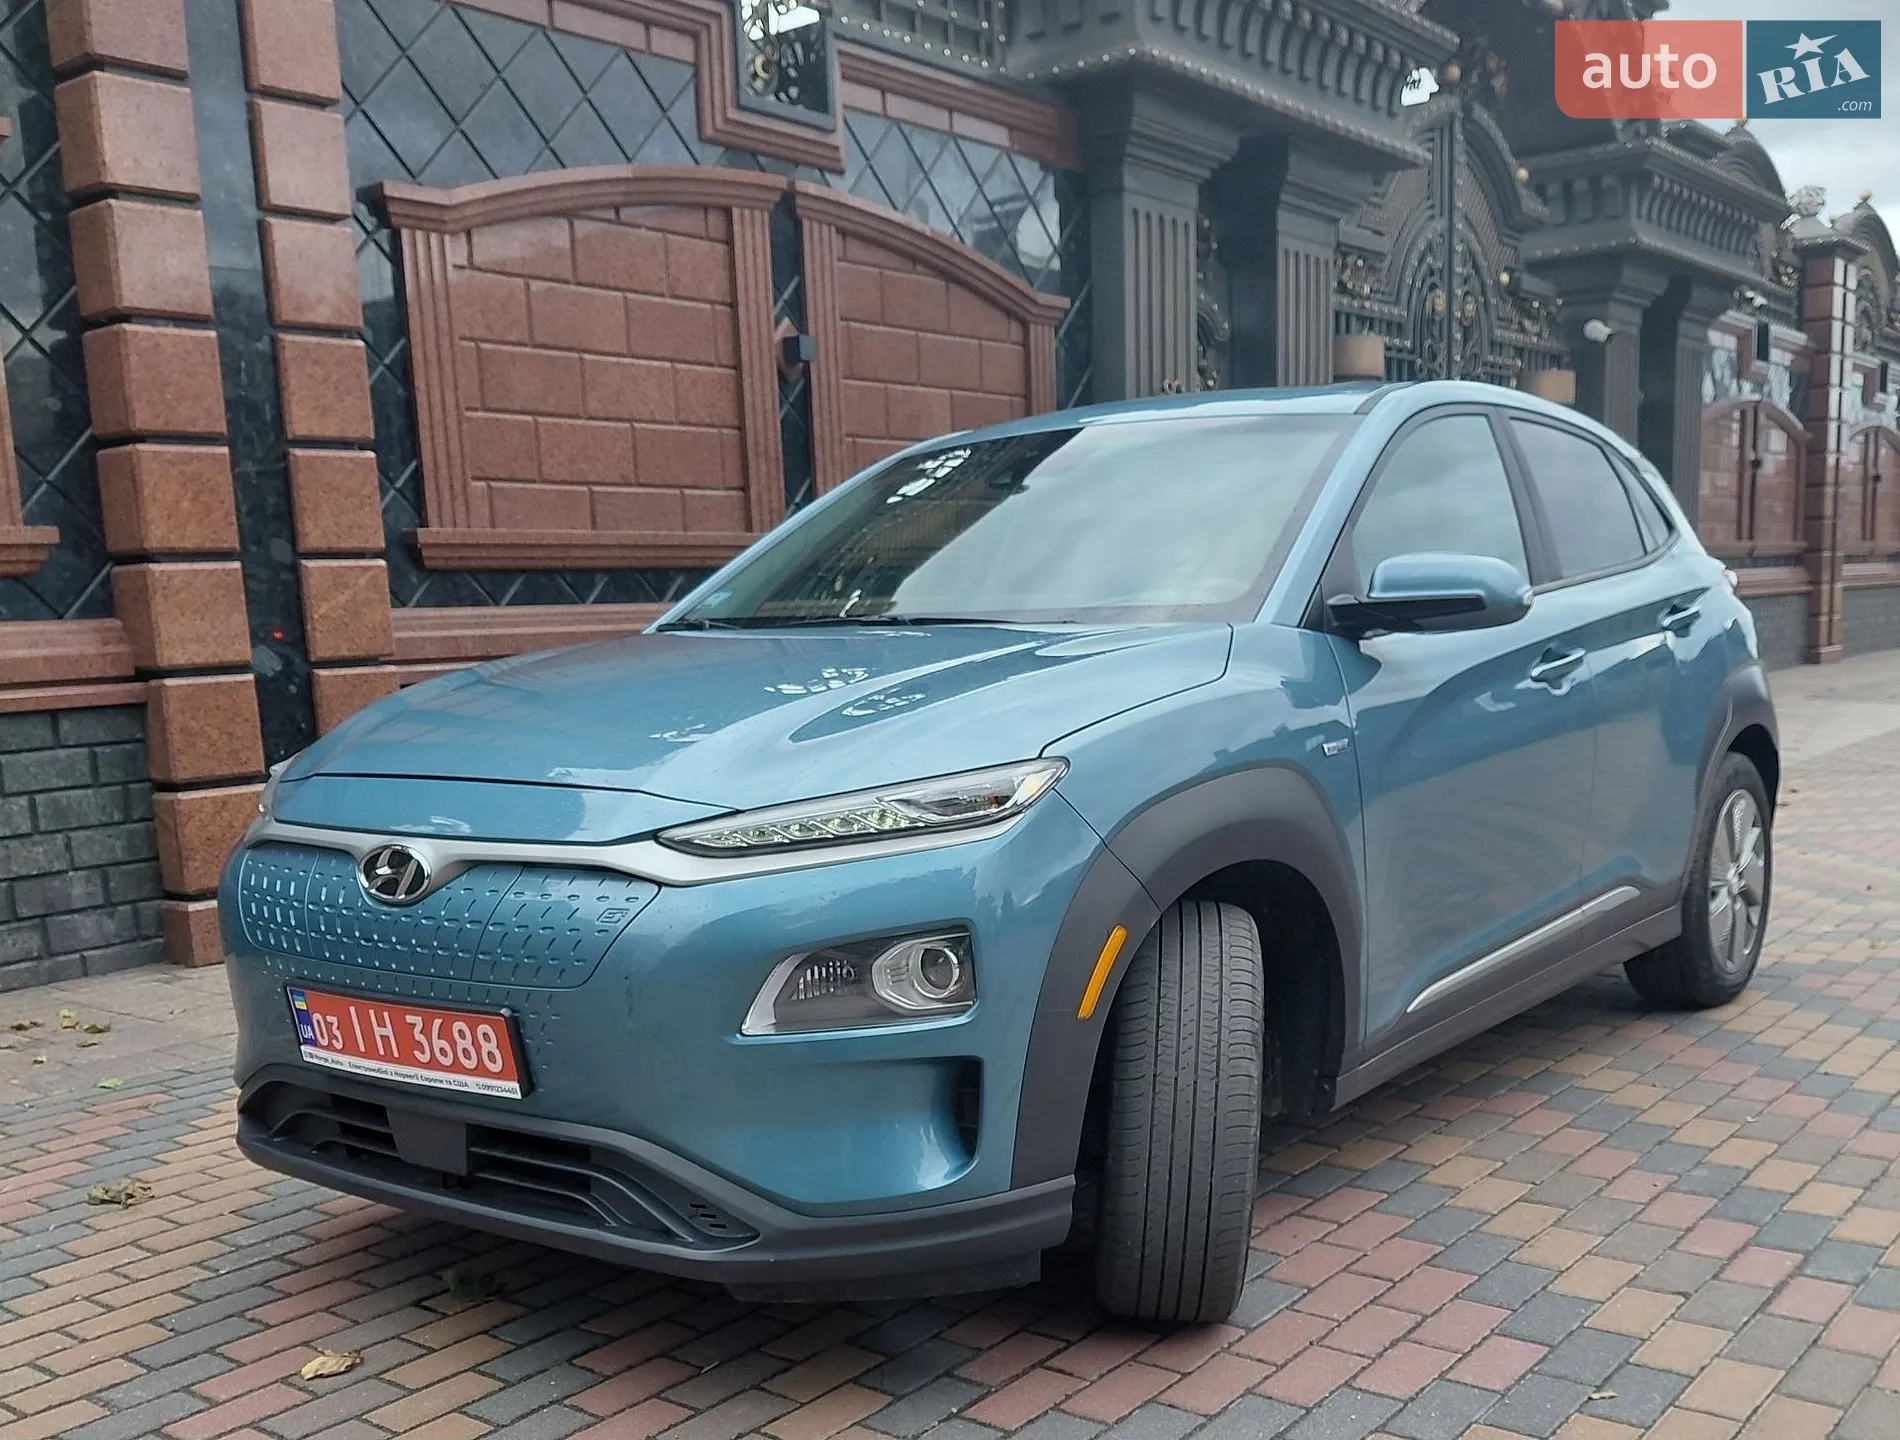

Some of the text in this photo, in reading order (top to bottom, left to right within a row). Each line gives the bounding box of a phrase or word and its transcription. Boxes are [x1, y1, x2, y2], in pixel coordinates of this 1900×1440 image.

[300, 1024, 315, 1041] UA
[312, 1013, 344, 1050] 03
[405, 1014, 504, 1073] 3688
